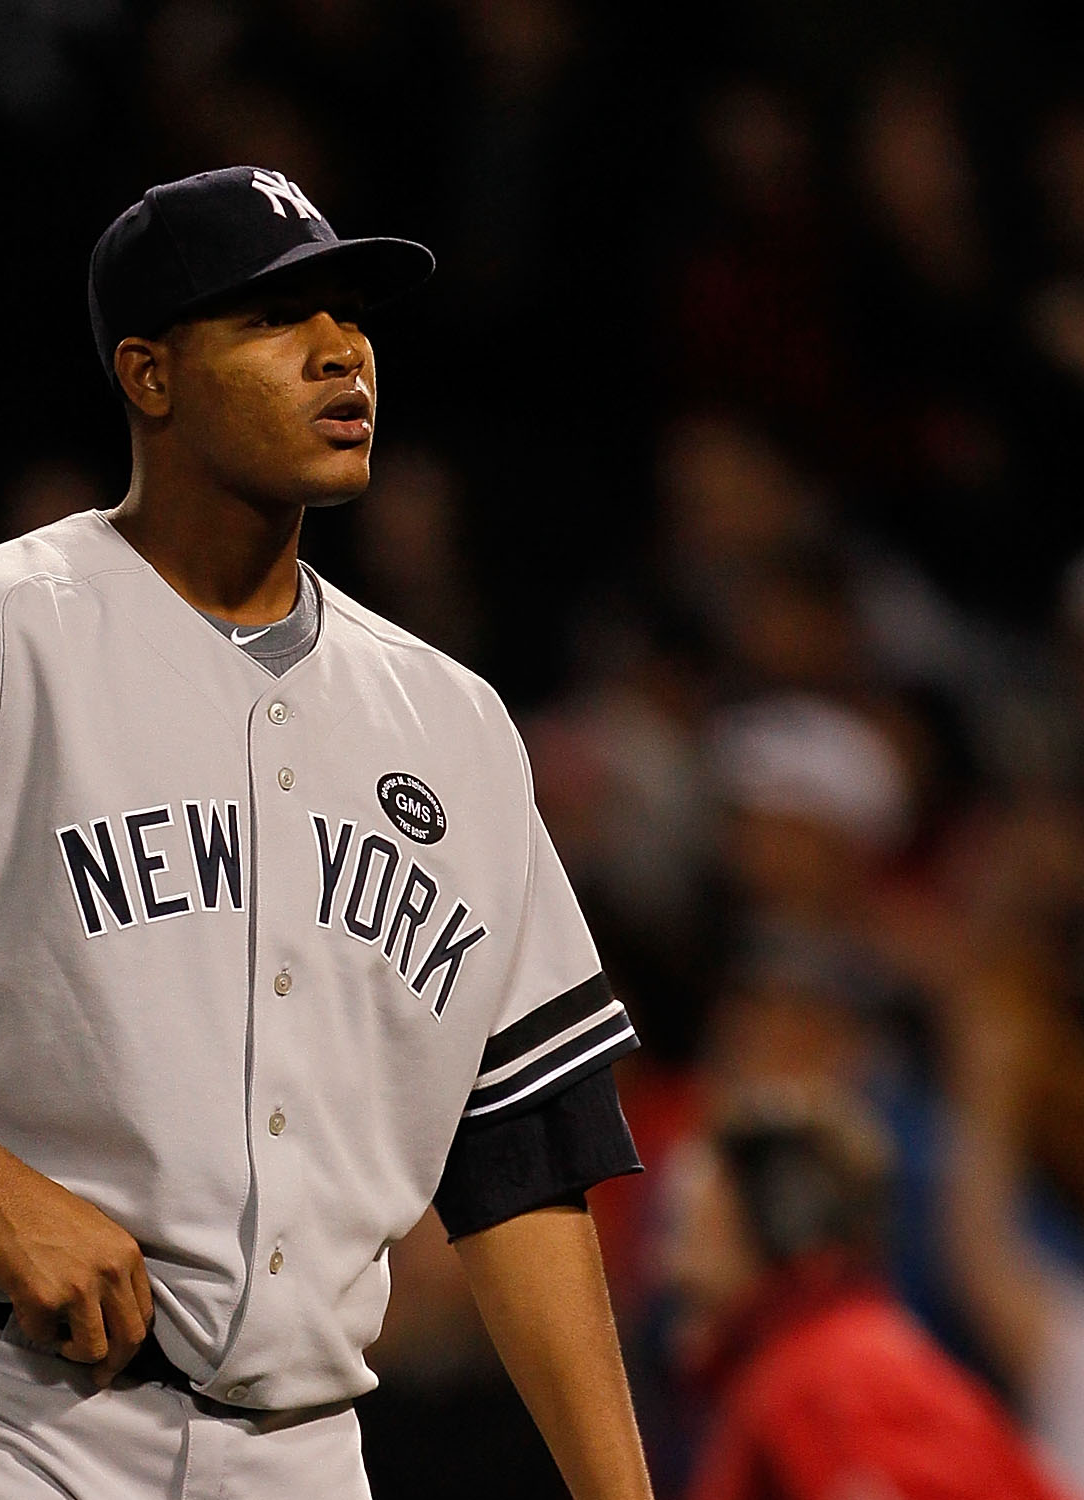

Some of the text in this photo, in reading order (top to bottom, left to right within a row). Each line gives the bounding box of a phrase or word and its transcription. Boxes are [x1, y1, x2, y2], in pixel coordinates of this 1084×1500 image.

[395, 792, 431, 823] GMS
[55, 798, 491, 1023] NEW YORK
